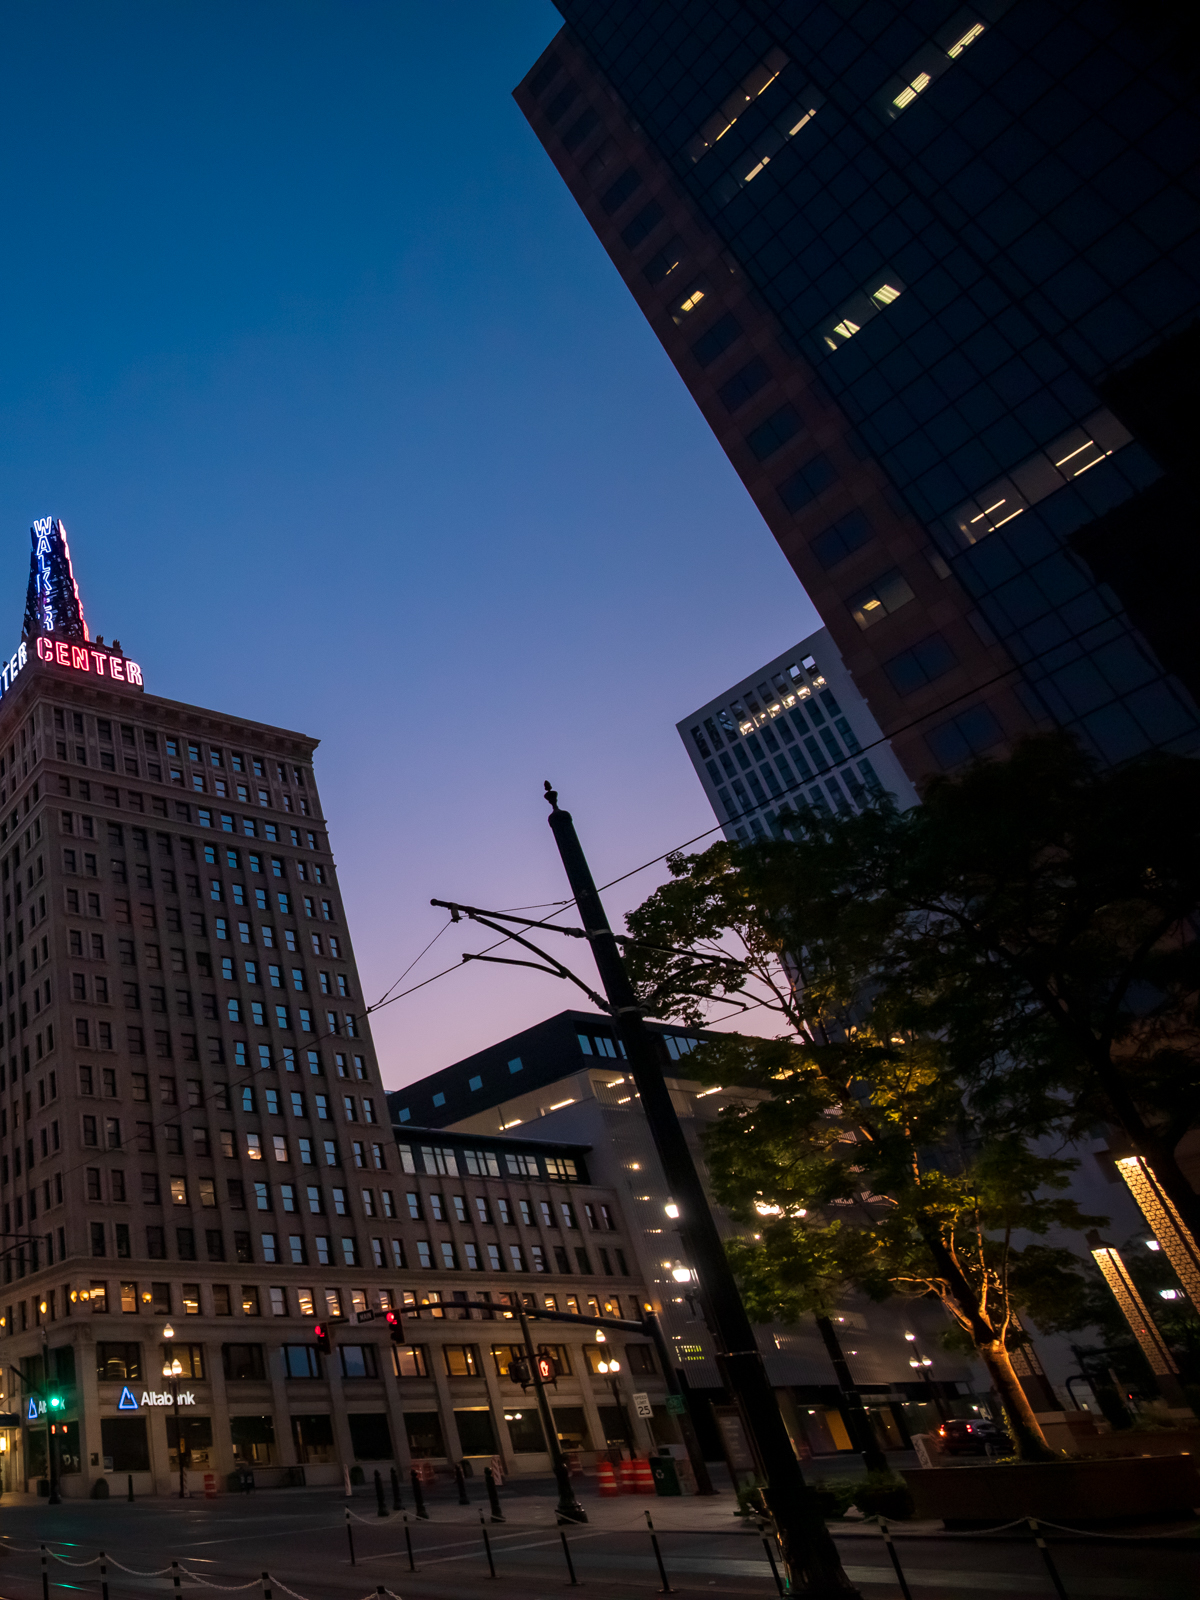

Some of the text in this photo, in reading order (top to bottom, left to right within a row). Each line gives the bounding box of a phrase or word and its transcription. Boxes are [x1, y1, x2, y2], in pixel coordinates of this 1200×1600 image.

[33, 516, 54, 632] WALKER
[36, 637, 143, 686] CENTER
[638, 1405, 651, 1416] 25
